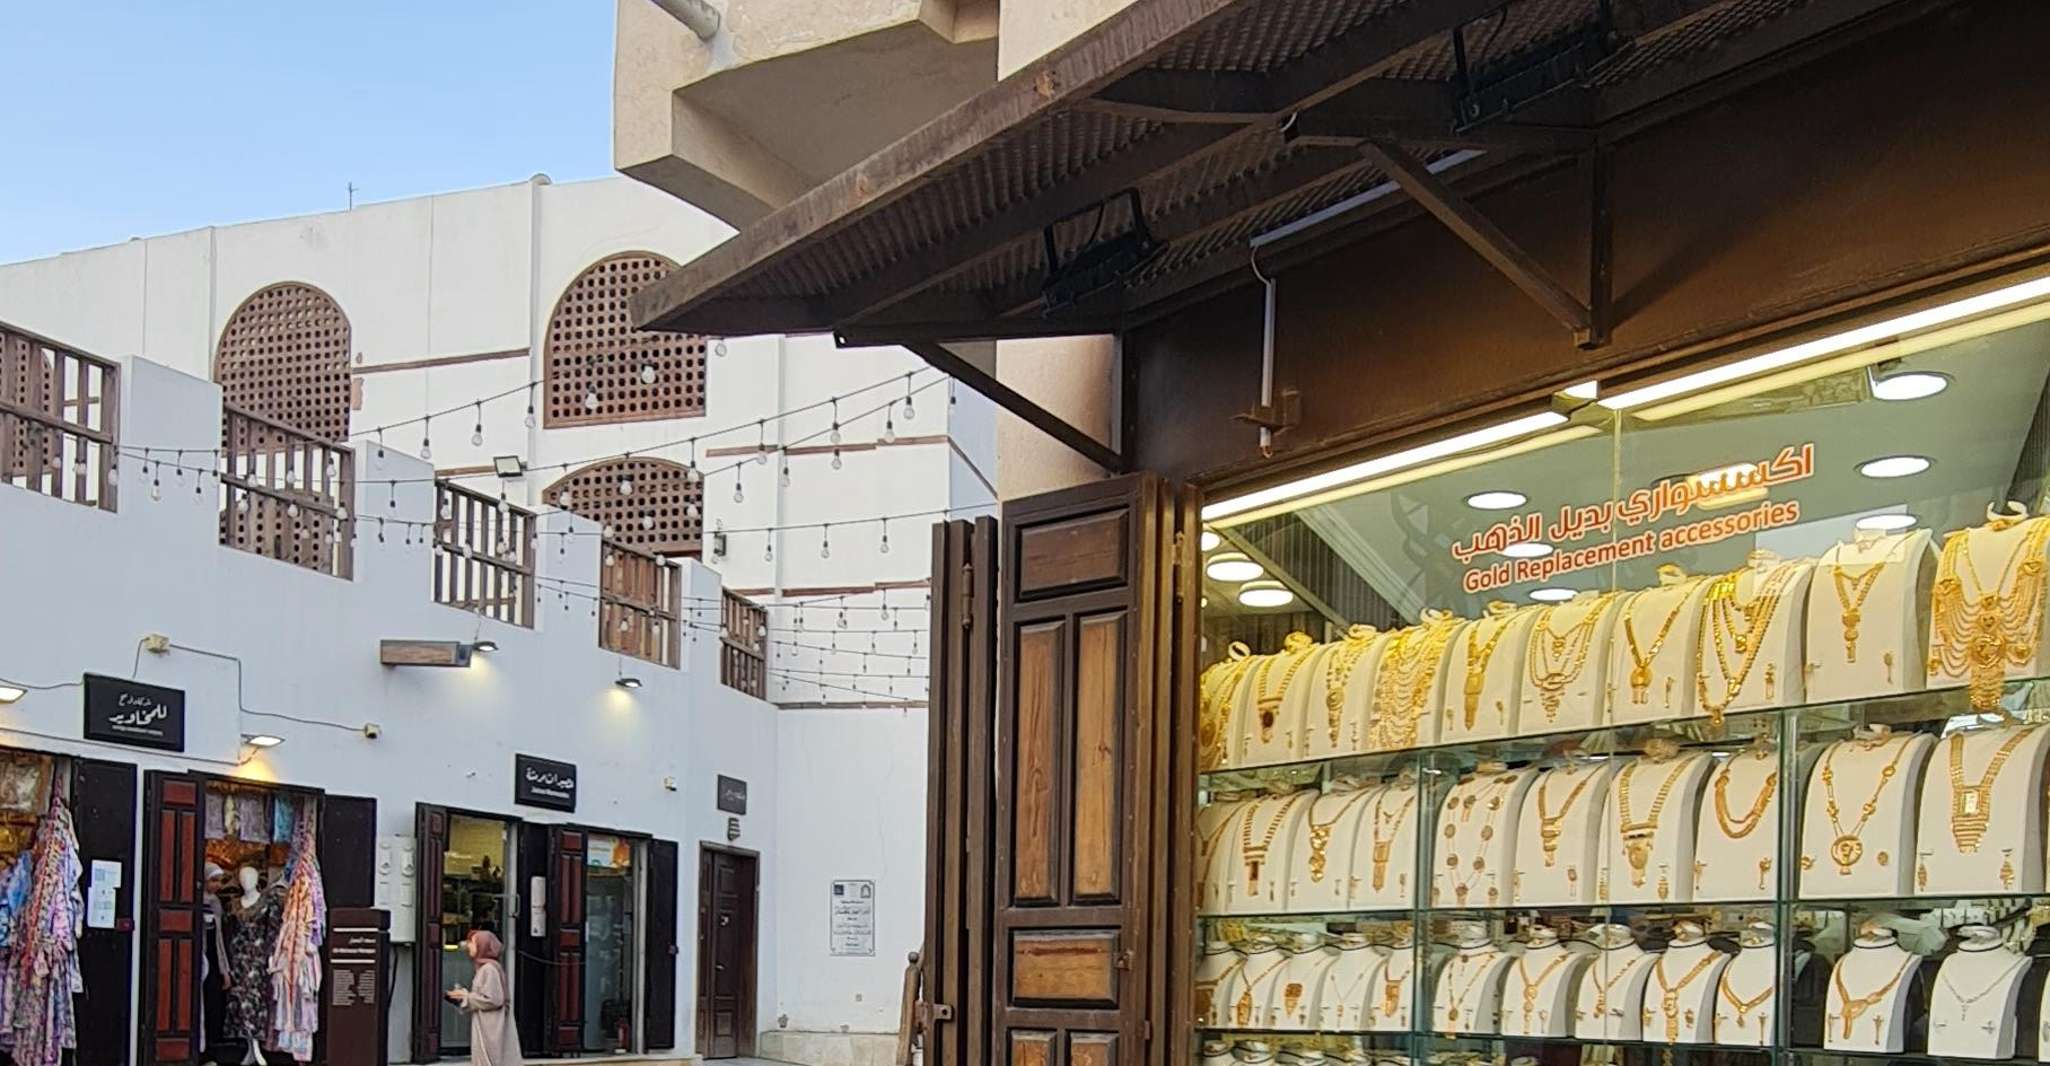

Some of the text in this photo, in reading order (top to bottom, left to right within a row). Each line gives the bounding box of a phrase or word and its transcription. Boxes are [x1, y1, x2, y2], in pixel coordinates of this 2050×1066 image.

[1452, 443, 1814, 563] اكسسواري بديل الذهب
[1464, 499, 1801, 592] Gold Replacement accessories
